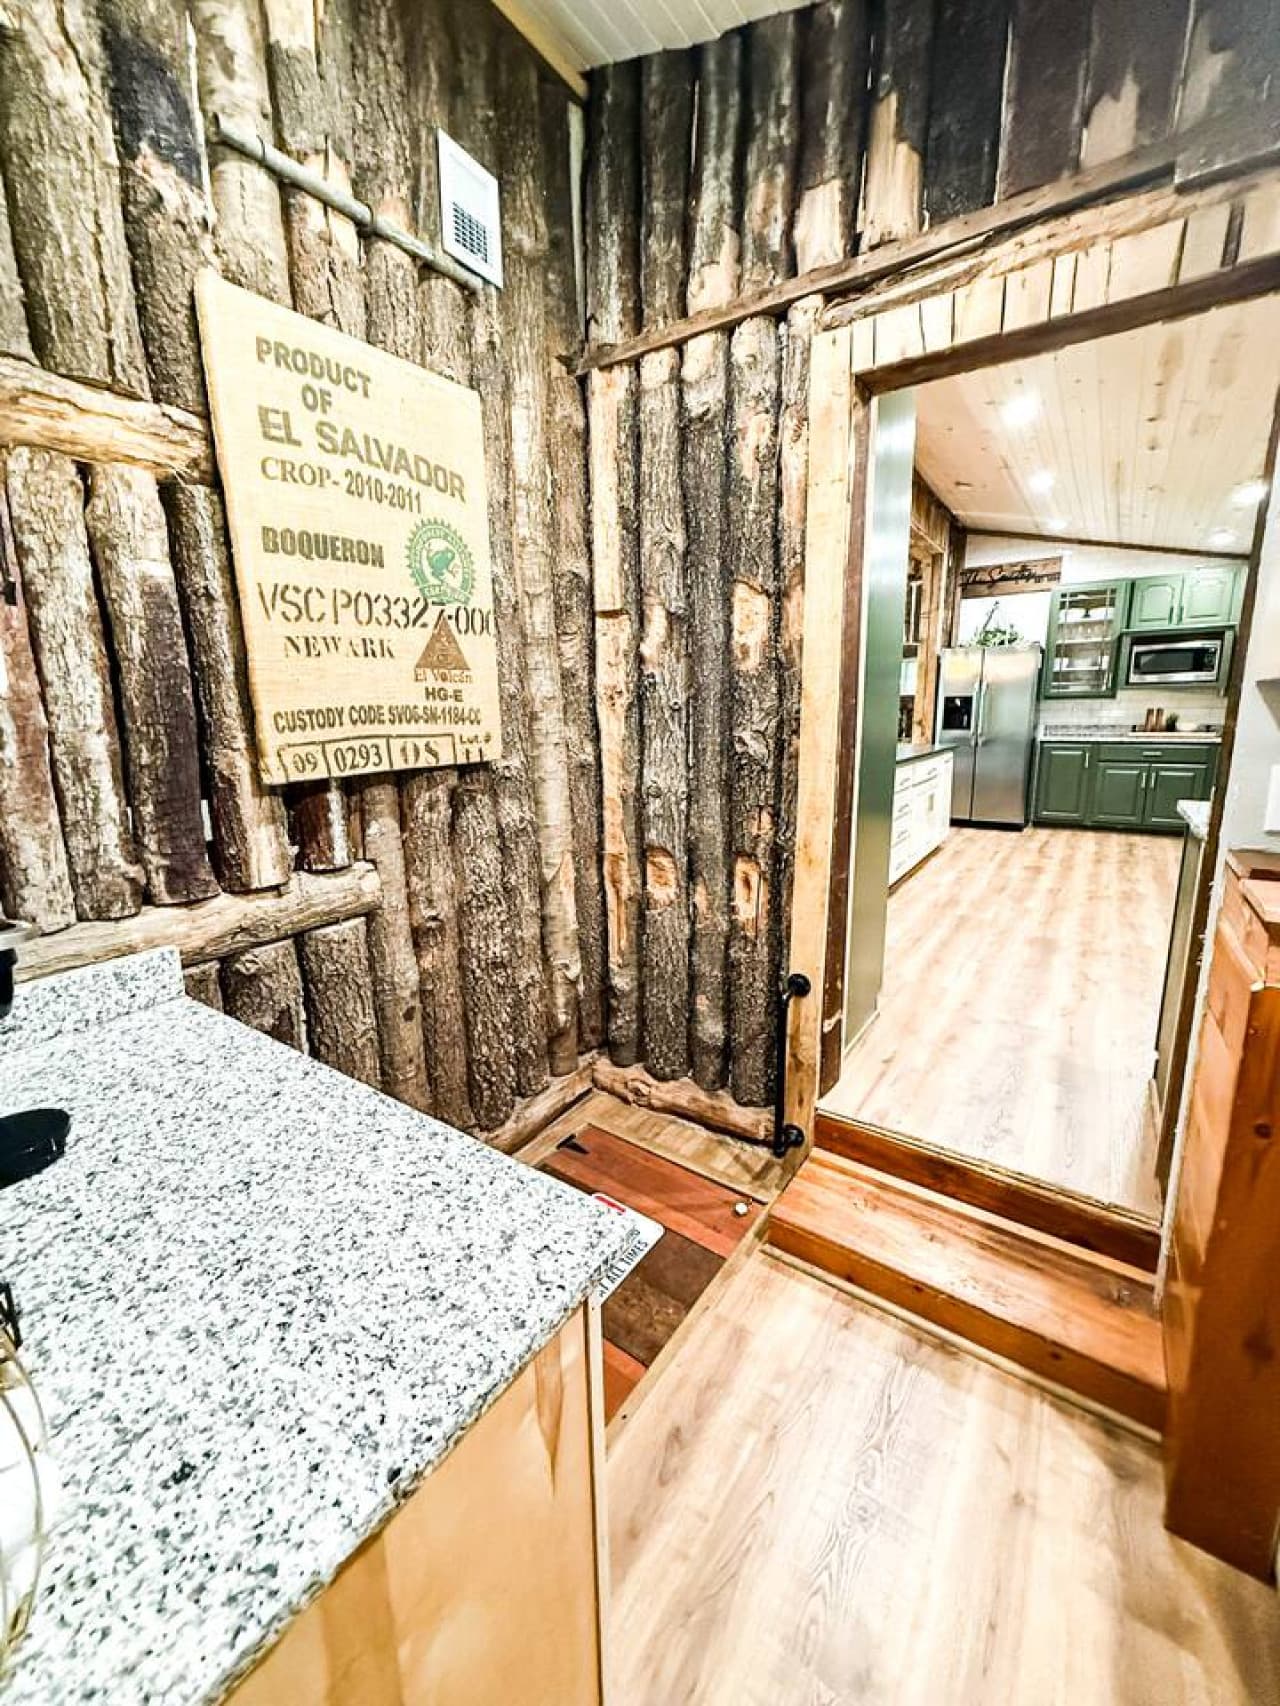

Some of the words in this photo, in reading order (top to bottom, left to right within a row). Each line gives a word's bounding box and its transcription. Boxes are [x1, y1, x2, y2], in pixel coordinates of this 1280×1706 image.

[255, 335, 371, 399] PRODUCT
[300, 383, 333, 414] OF
[257, 404, 302, 447] EL
[314, 420, 467, 504] SALVADOR
[261, 526, 385, 569] BOQUERON
[283, 635, 395, 659] NEWARK
[273, 706, 344, 733] CUSTODY
[349, 705, 385, 726] CODE
[333, 744, 383, 772] 0293
